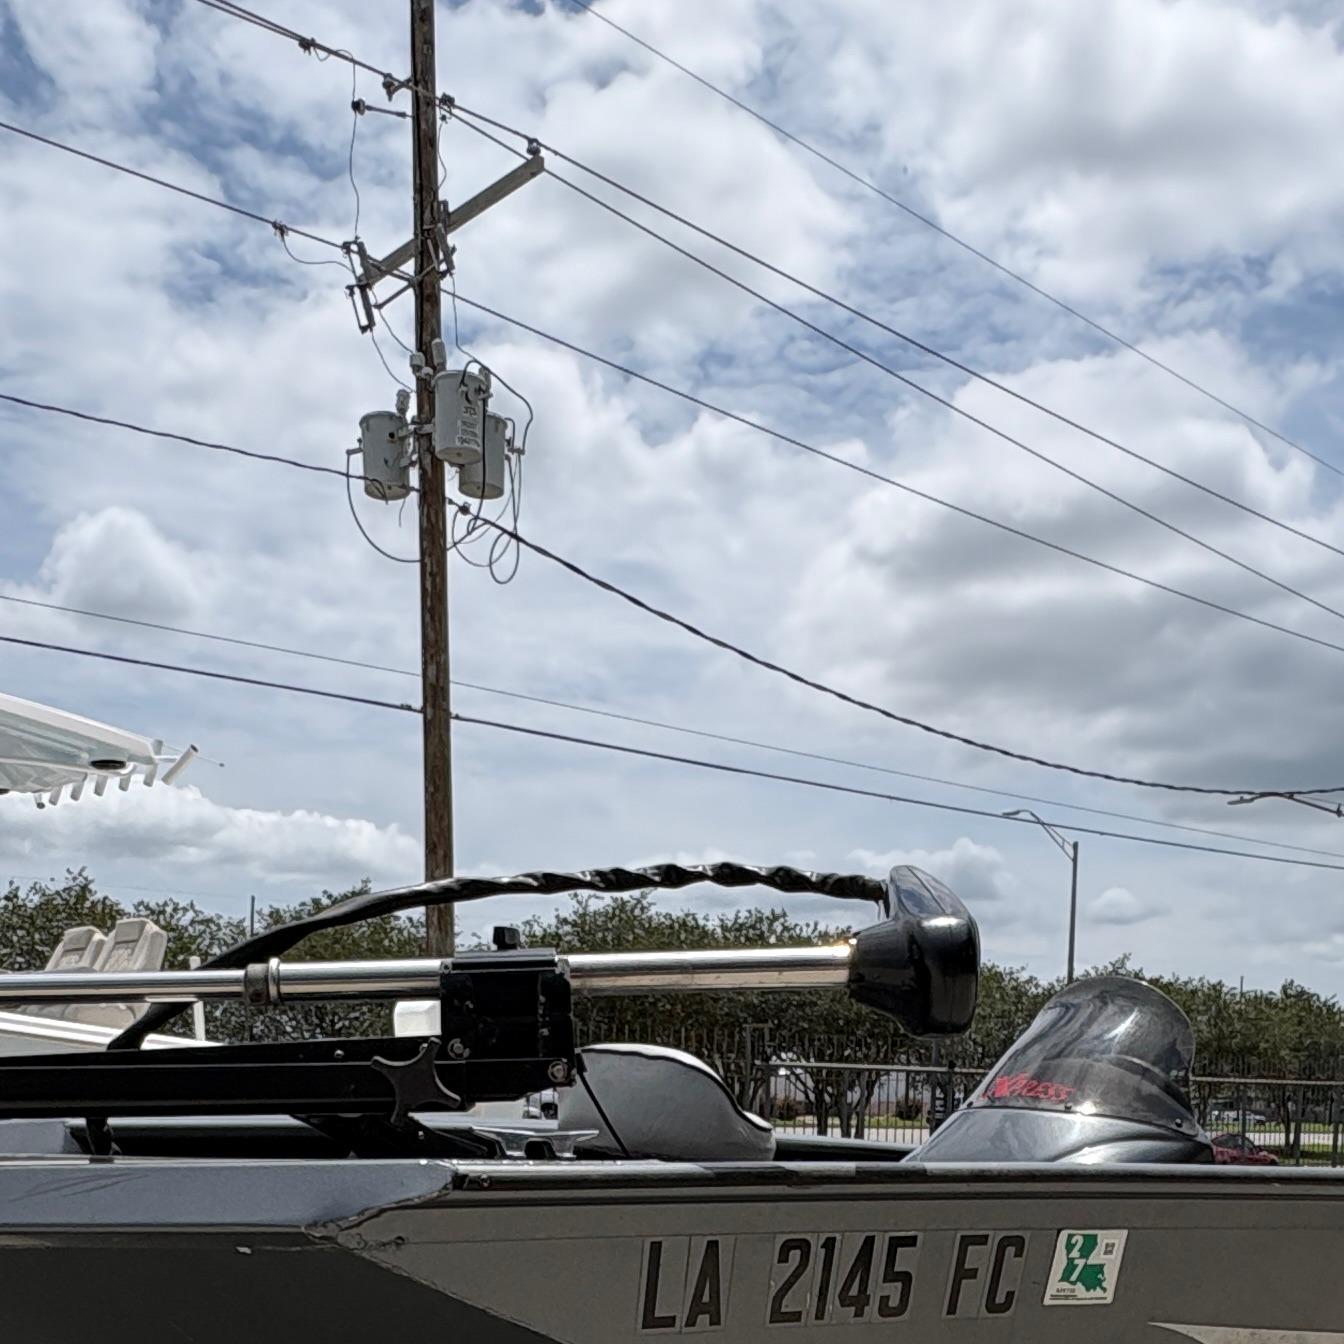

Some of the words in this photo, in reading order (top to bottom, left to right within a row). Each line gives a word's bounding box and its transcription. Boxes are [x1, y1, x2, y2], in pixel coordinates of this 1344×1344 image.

[1068, 1234, 1084, 1258] 2
[1069, 1258, 1087, 1281] 7
[641, 1240, 722, 1330] LA
[768, 1234, 919, 1325] 2145
[946, 1234, 1026, 1317] FC
